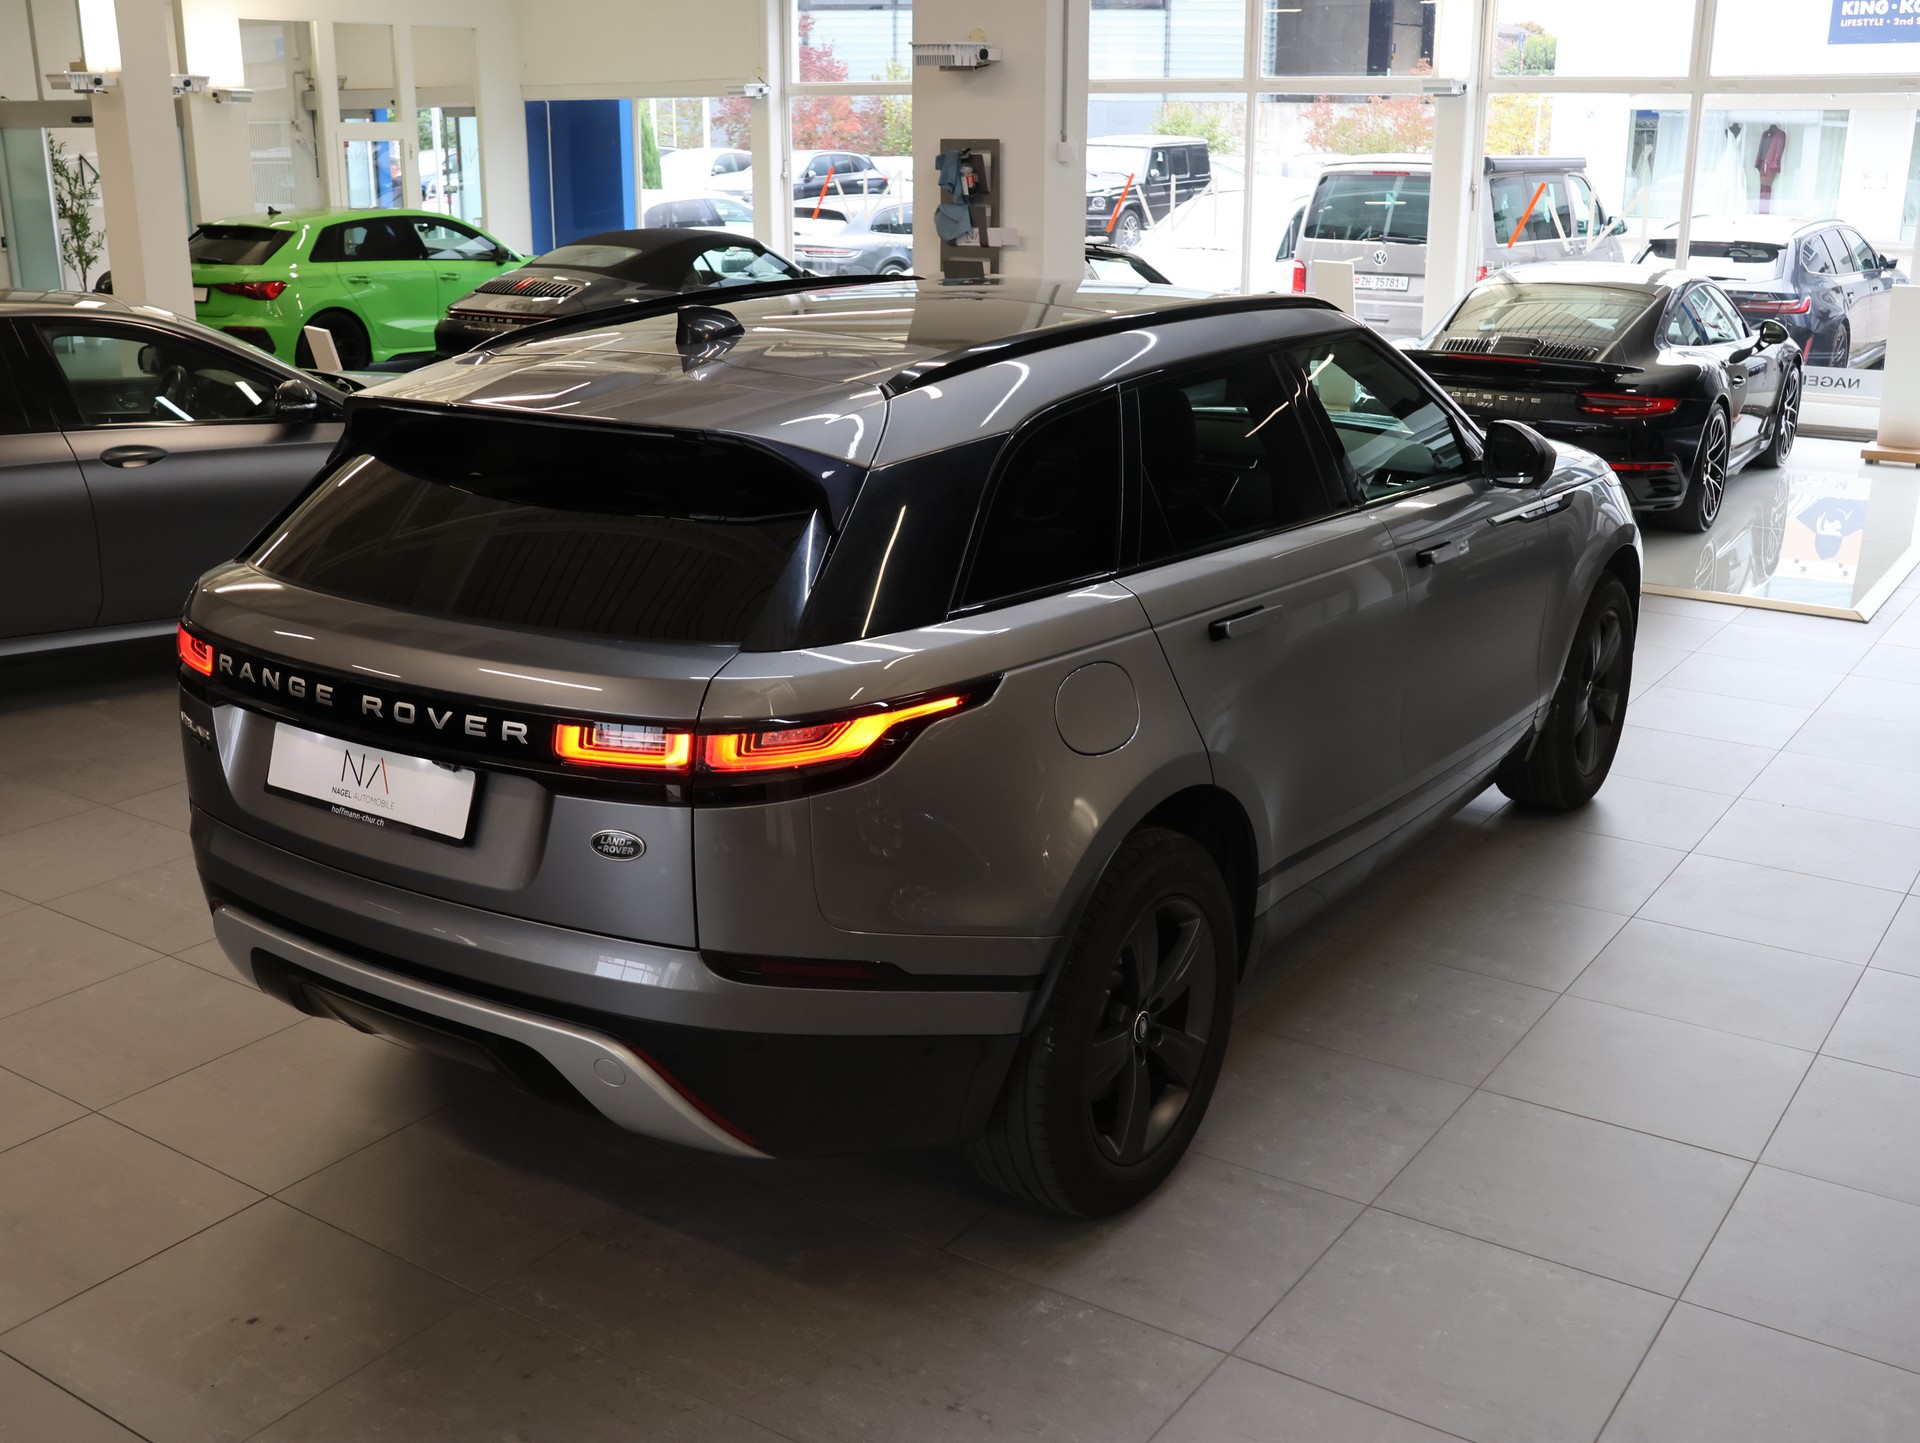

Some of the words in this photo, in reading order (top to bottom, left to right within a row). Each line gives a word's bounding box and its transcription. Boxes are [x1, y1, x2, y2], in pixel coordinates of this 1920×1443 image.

[1841, 0, 1889, 15] KING
[1840, 18, 1884, 27] LIFESTYLE
[1893, 16, 1914, 26] 2nd
[1451, 391, 1541, 404] ORSCHE
[218, 653, 334, 706] RANGE
[361, 694, 529, 745] ROVER
[331, 786, 352, 799] NAGEL
[353, 792, 395, 811] AUTOMOBILE
[331, 805, 385, 827] hoffmann-chur.ch
[600, 835, 626, 846] LAND
[602, 844, 634, 855] ROVER
